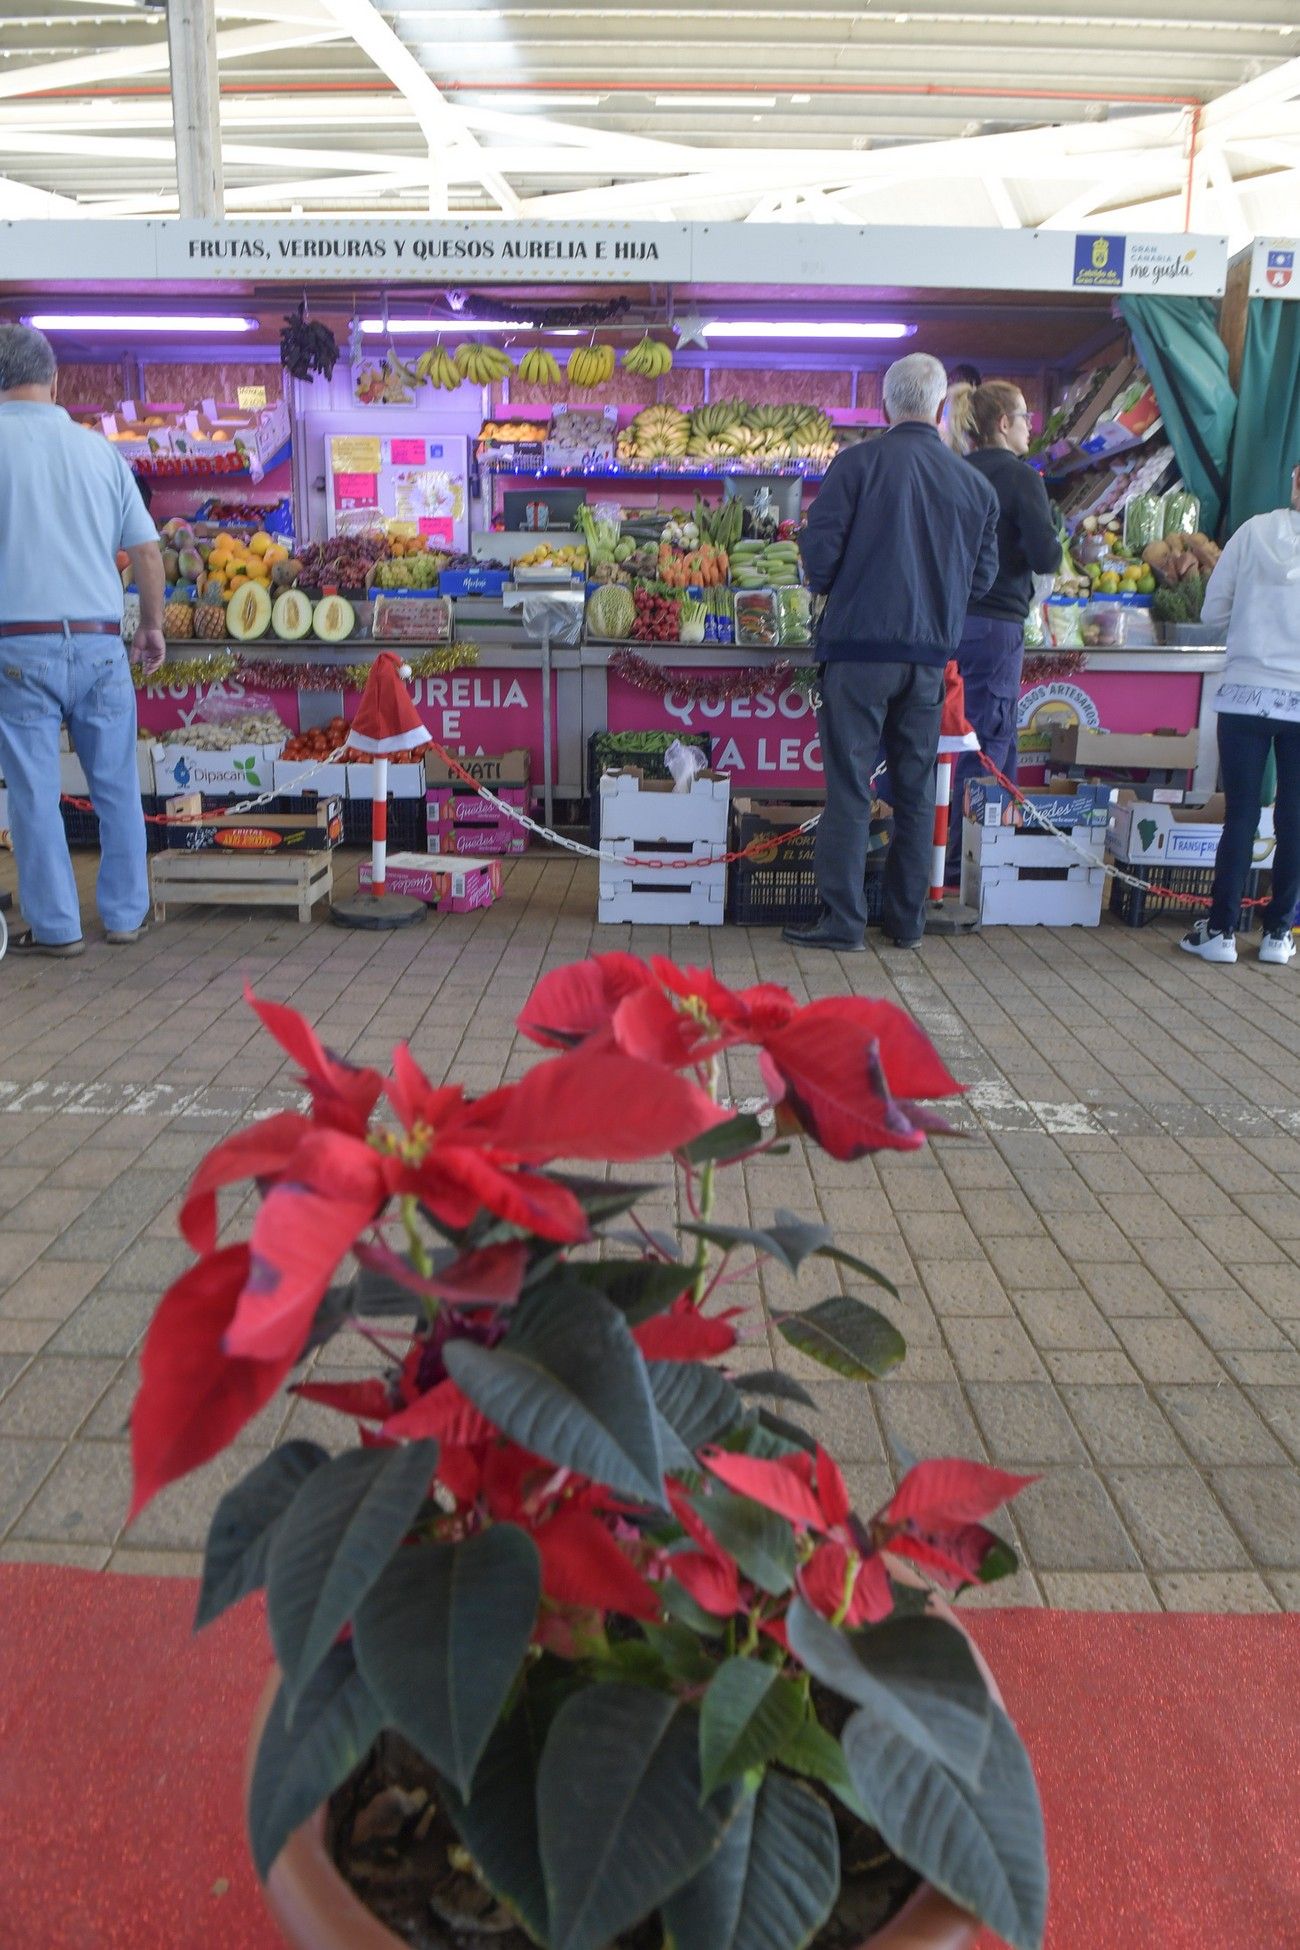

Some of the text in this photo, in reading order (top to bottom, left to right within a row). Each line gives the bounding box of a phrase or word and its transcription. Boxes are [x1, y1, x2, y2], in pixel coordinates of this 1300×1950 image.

[188, 239, 659, 260] FRUTAS, VERDURAS Y QUESOS AURELIA E HIJA
[1131, 245, 1158, 253] GRAN
[1131, 254, 1172, 262] CANARIA
[1130, 254, 1193, 285] me gusta
[146, 676, 245, 700] RUTAS
[411, 678, 529, 708] URELIA
[664, 688, 811, 725] QUESO
[1050, 684, 1097, 725] ARTESANOS
[442, 710, 461, 739] E
[194, 768, 246, 783] Dipacan
[456, 801, 494, 820] Guedes
[1023, 801, 1071, 826] Guedes
[456, 833, 495, 853] Guedes
